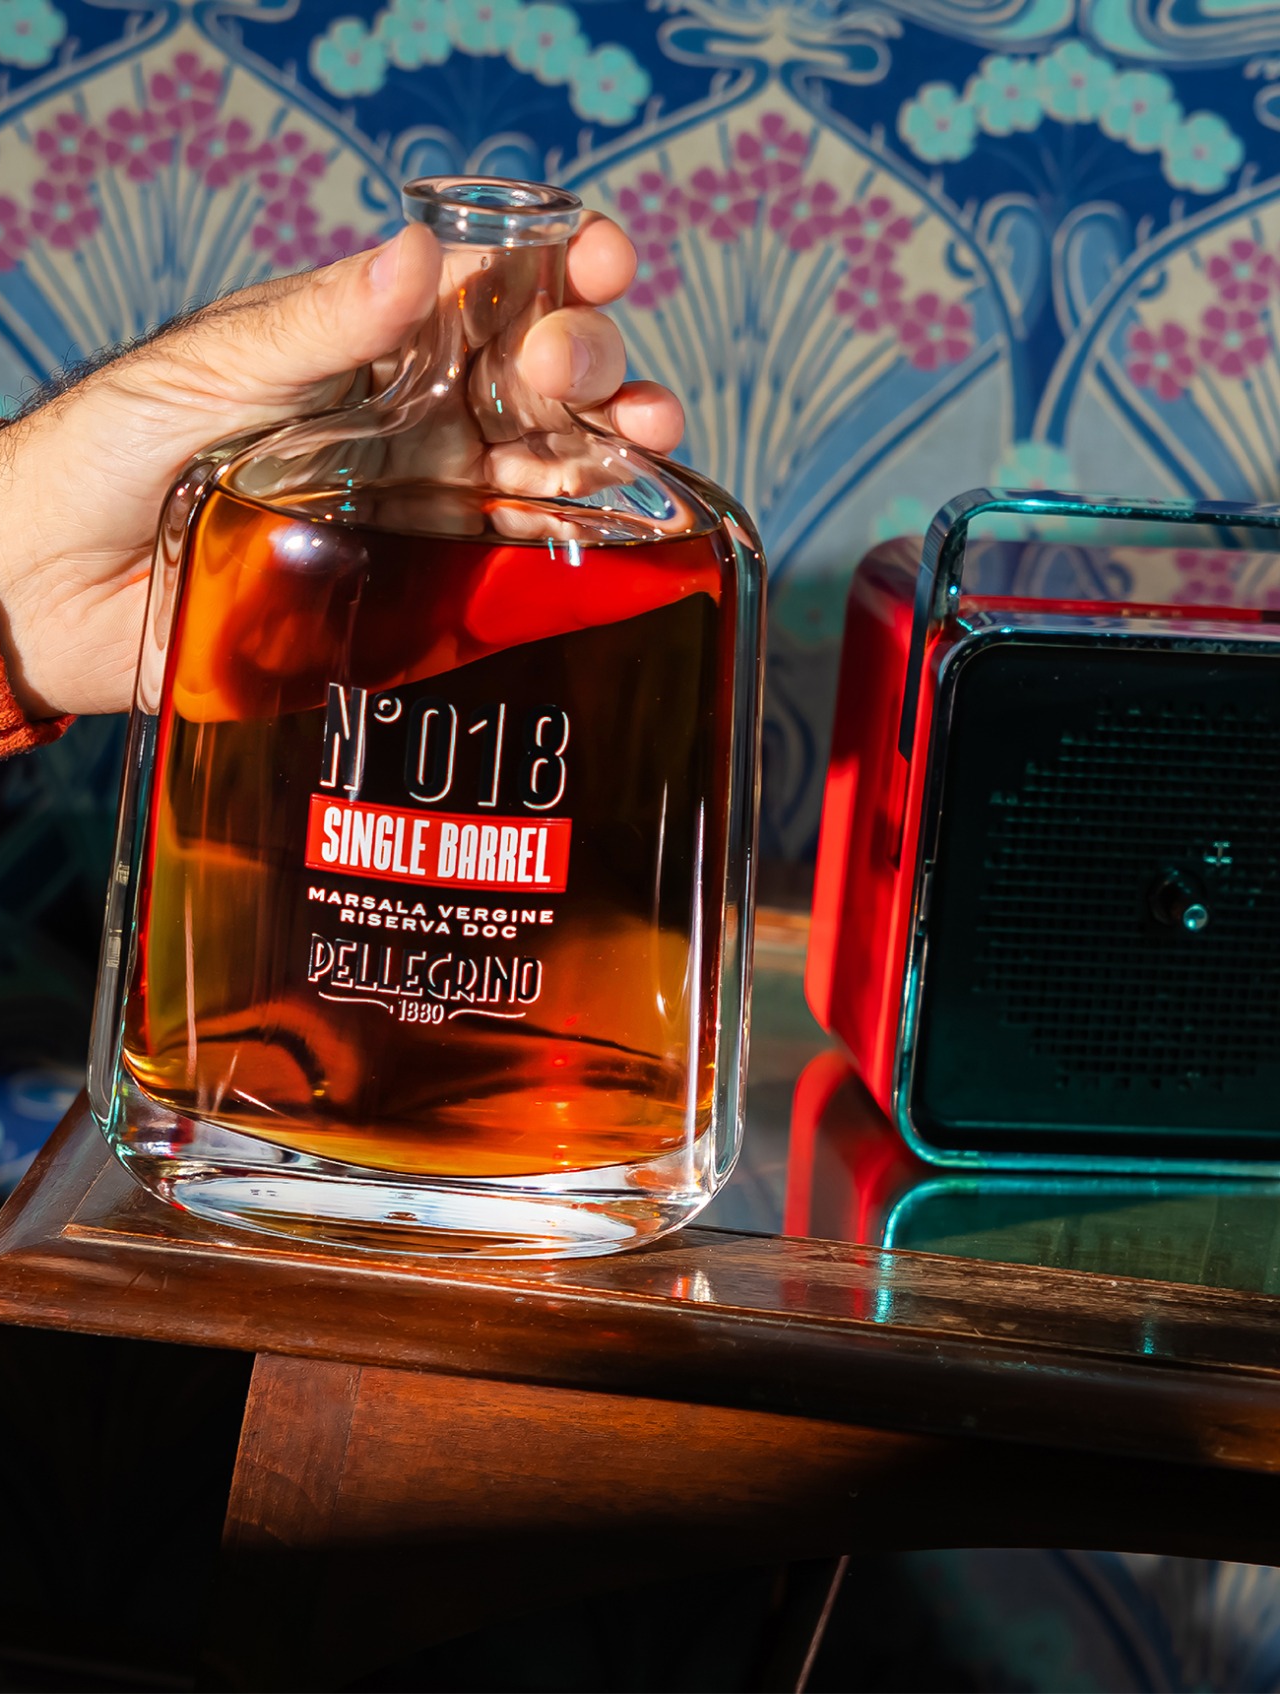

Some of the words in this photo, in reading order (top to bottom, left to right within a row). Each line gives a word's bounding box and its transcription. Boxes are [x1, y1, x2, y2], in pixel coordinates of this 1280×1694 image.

[321, 806, 430, 876] SINGLE
[437, 822, 552, 884] BARREL
[308, 886, 427, 917] MARSALA
[438, 904, 554, 924] VERGINE
[340, 908, 451, 935] RISERVA
[462, 923, 518, 939] DOC
[307, 932, 543, 1005] PELLEGRINO
[398, 999, 445, 1025] 1880
